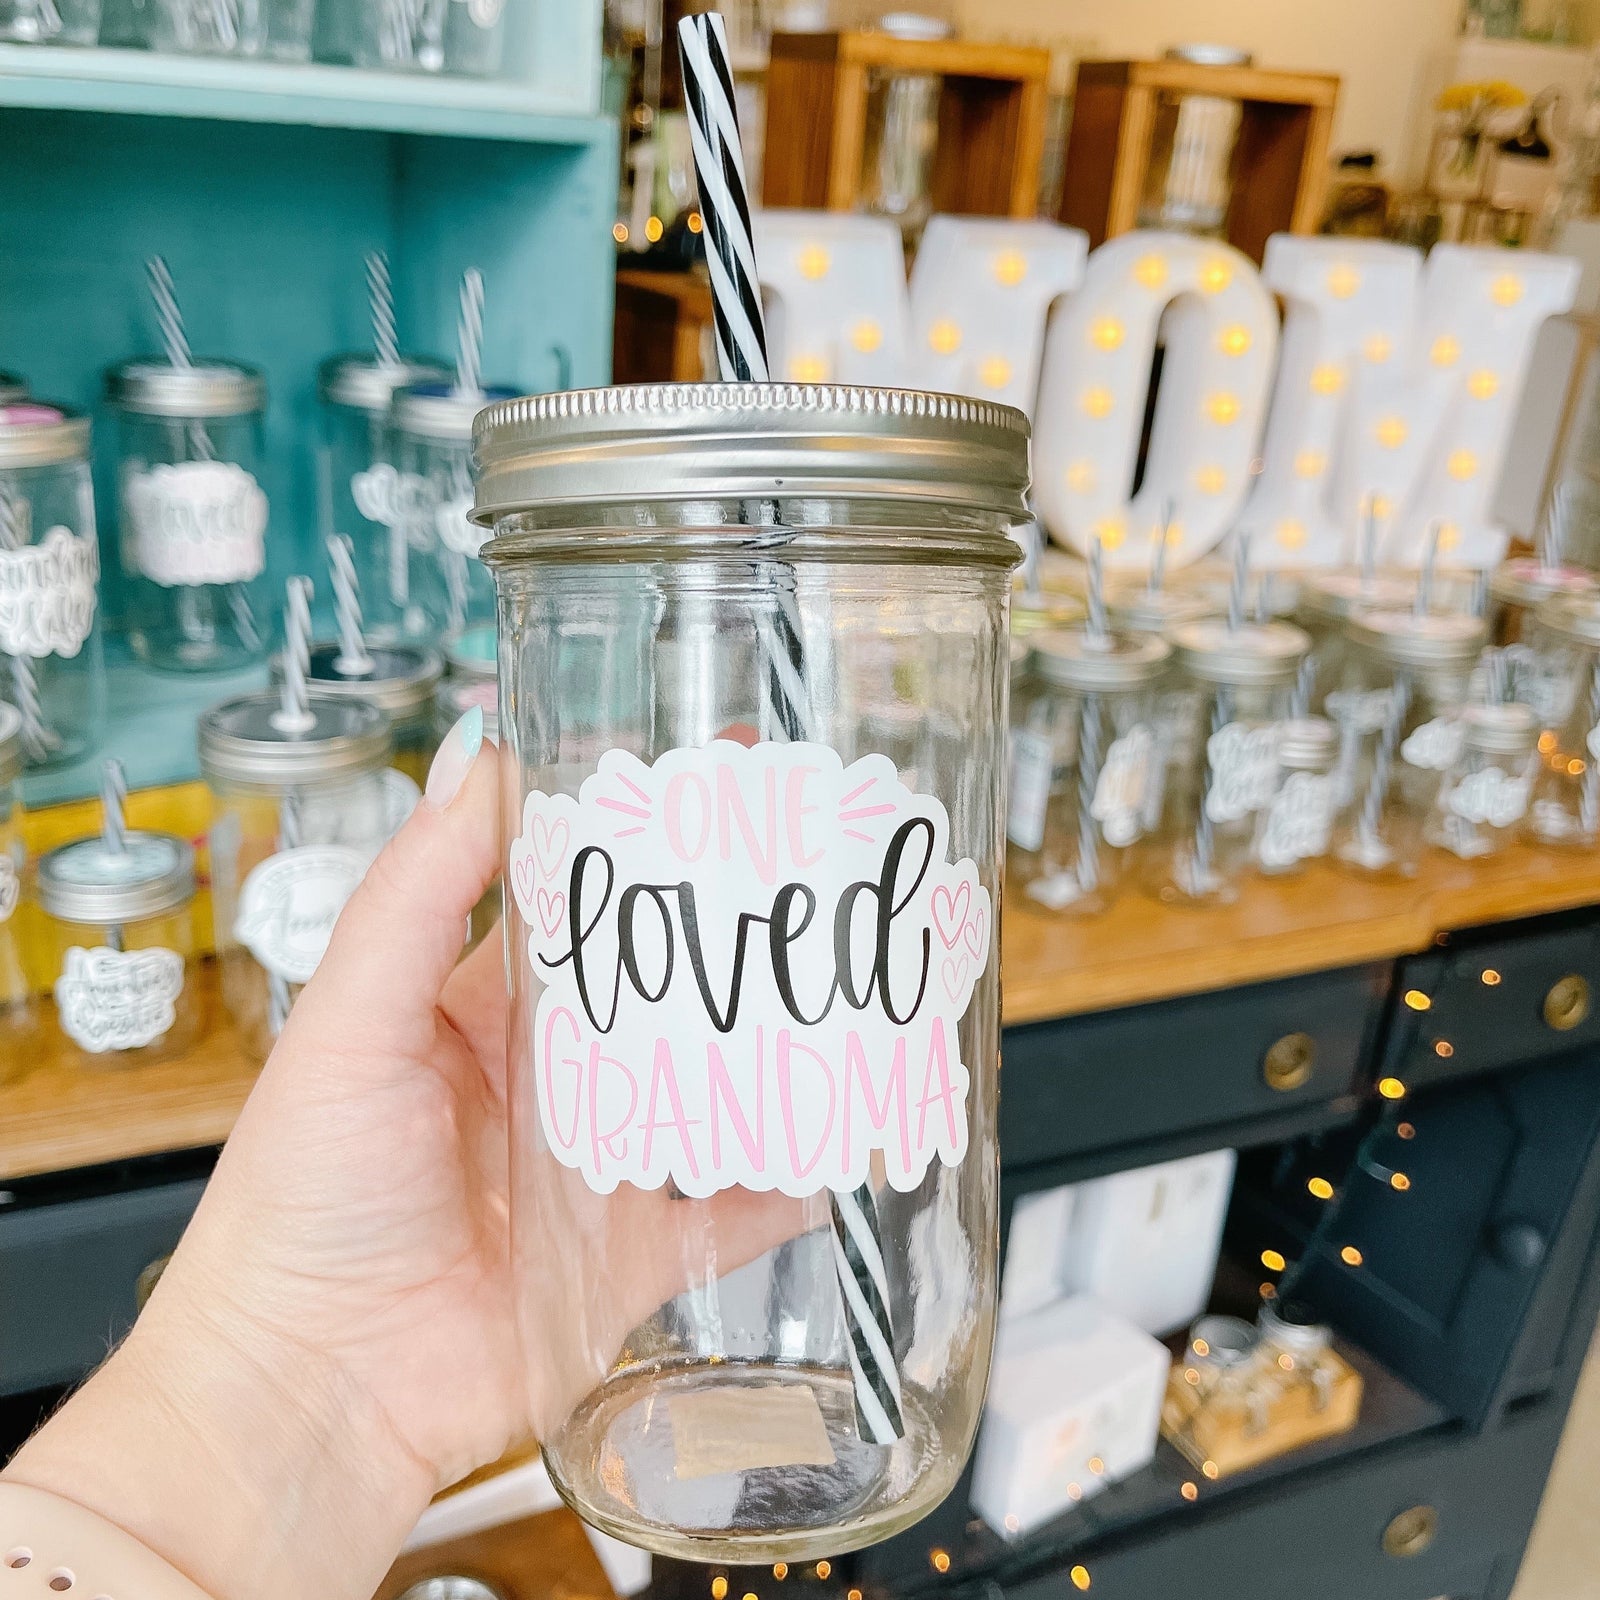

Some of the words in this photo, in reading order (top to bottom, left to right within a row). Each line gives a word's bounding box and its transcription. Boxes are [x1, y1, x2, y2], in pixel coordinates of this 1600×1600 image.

[664, 763, 826, 886] ONE
[537, 817, 935, 1033] loved
[544, 1006, 959, 1179] GRANDMA
